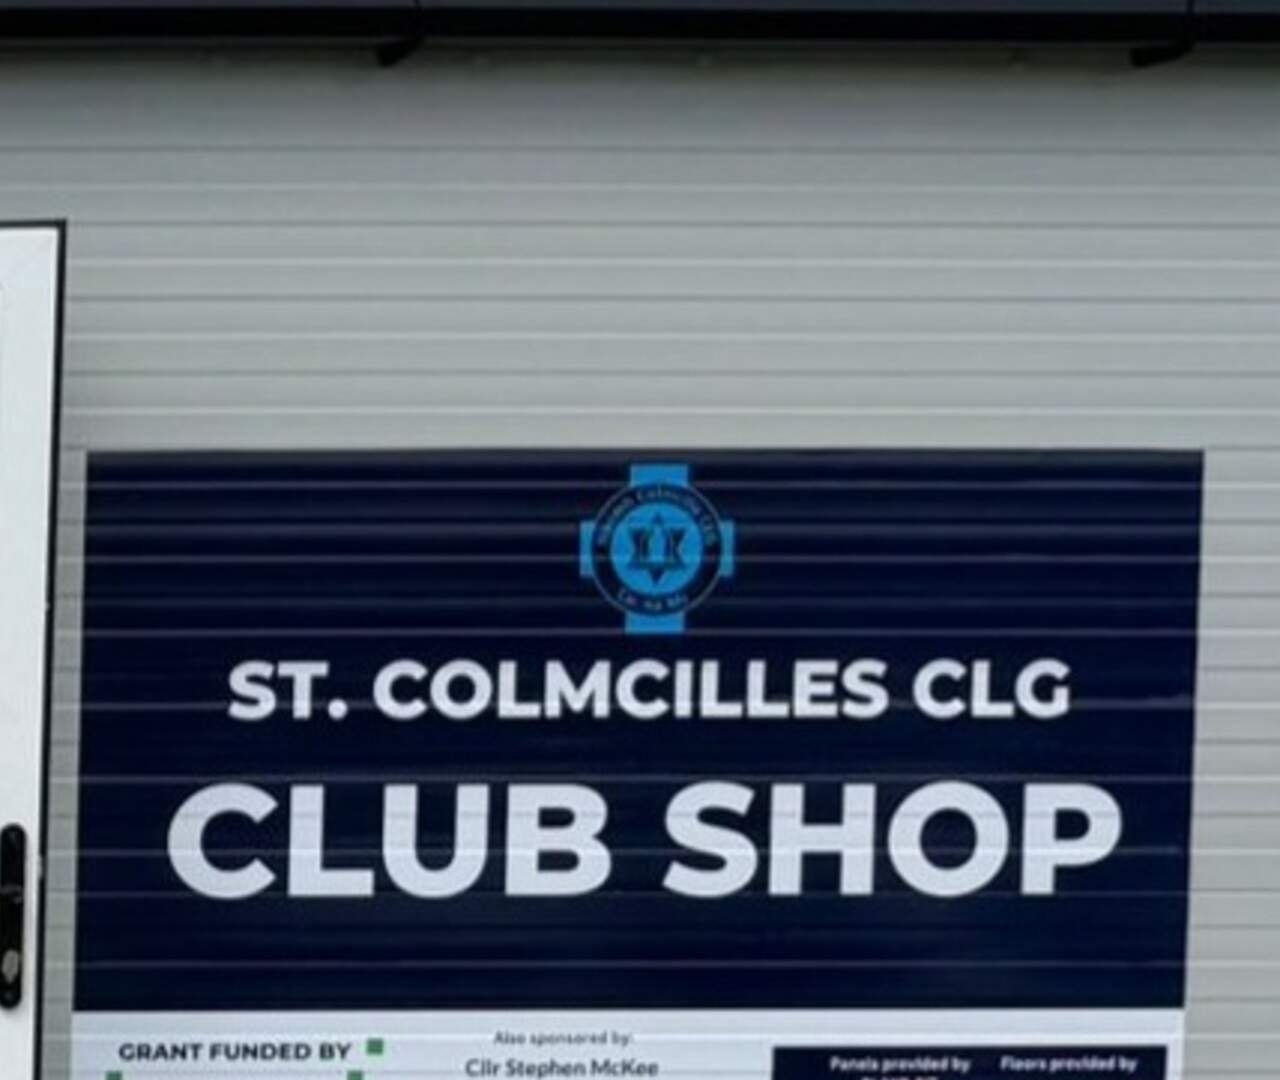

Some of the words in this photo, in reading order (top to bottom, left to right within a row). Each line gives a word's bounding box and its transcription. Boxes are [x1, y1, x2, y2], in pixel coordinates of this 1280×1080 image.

[227, 659, 348, 719] ST.
[373, 659, 890, 719] COLMCILLES
[912, 658, 1070, 718] CLG
[167, 783, 612, 899] CLUB
[663, 780, 1122, 898] SHOP
[493, 1031, 527, 1045] Also
[530, 1031, 608, 1047] sponsored
[118, 1043, 202, 1061] GRANT
[209, 1043, 312, 1061] FUNDED
[319, 1043, 351, 1060] BY
[505, 1058, 587, 1080] Stephen
[590, 1058, 659, 1077] McKee
